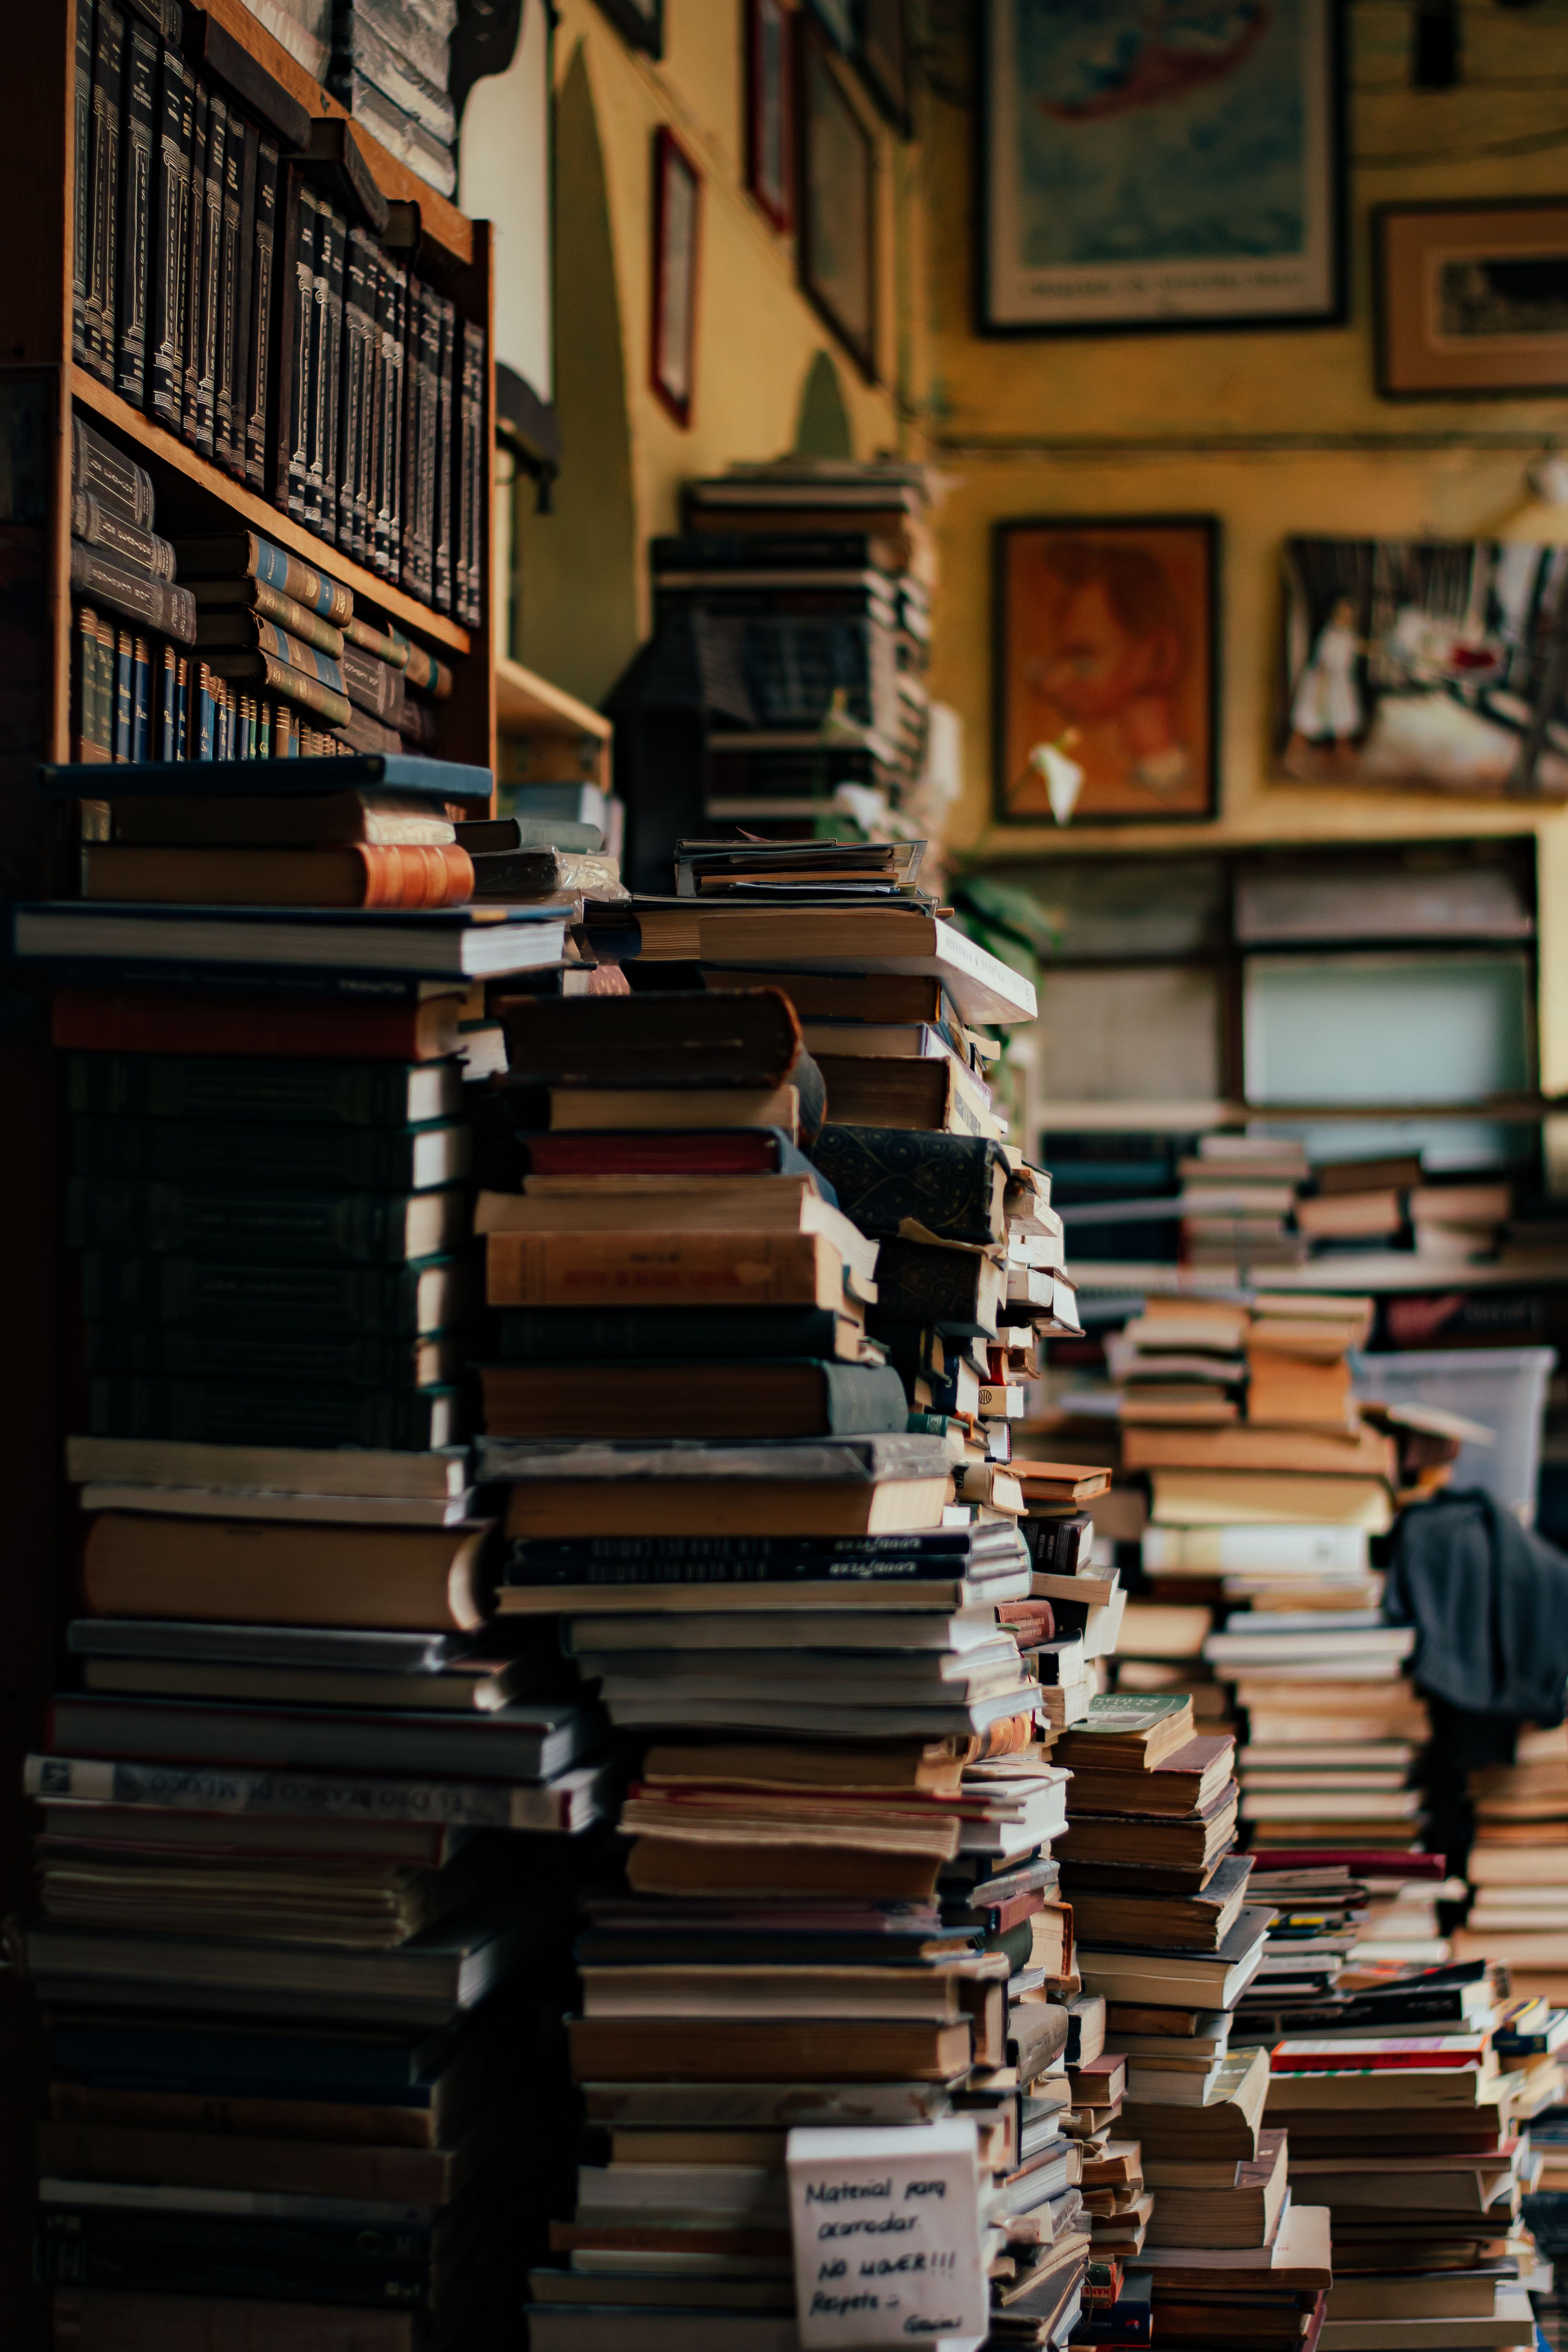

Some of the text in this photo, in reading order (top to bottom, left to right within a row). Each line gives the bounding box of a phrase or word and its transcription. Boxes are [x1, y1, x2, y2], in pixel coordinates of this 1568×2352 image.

[834, 1536, 922, 1553] GOODYEAR
[829, 1559, 918, 1578] GOODYEAR
[806, 2176, 893, 2207] Material
[818, 2257, 847, 2282] NO
